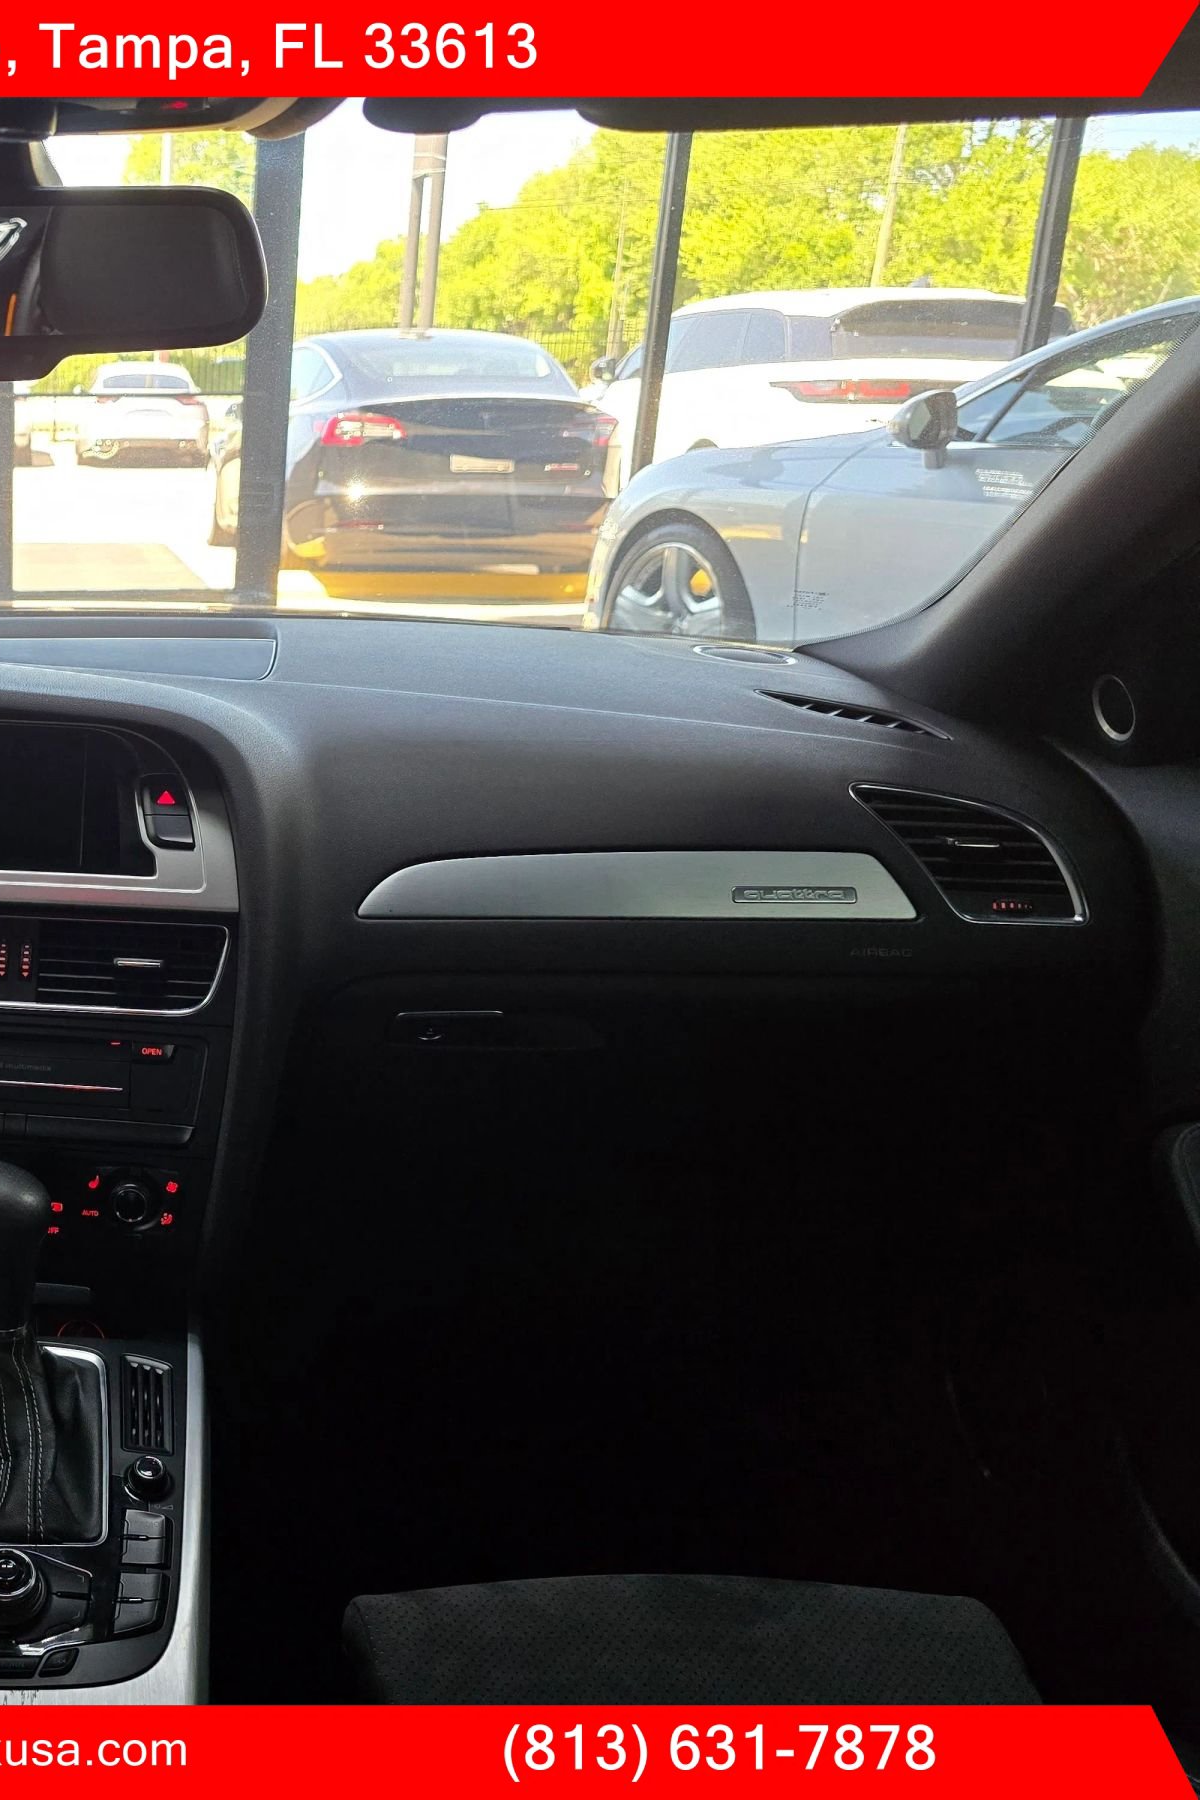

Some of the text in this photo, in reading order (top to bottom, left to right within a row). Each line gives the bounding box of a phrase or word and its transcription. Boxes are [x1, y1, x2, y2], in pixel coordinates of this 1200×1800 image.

[743, 887, 846, 900] quattro
[849, 946, 913, 958] AIRBAG
[141, 1047, 162, 1057] OPEN
[81, 1208, 99, 1217] AUTO
